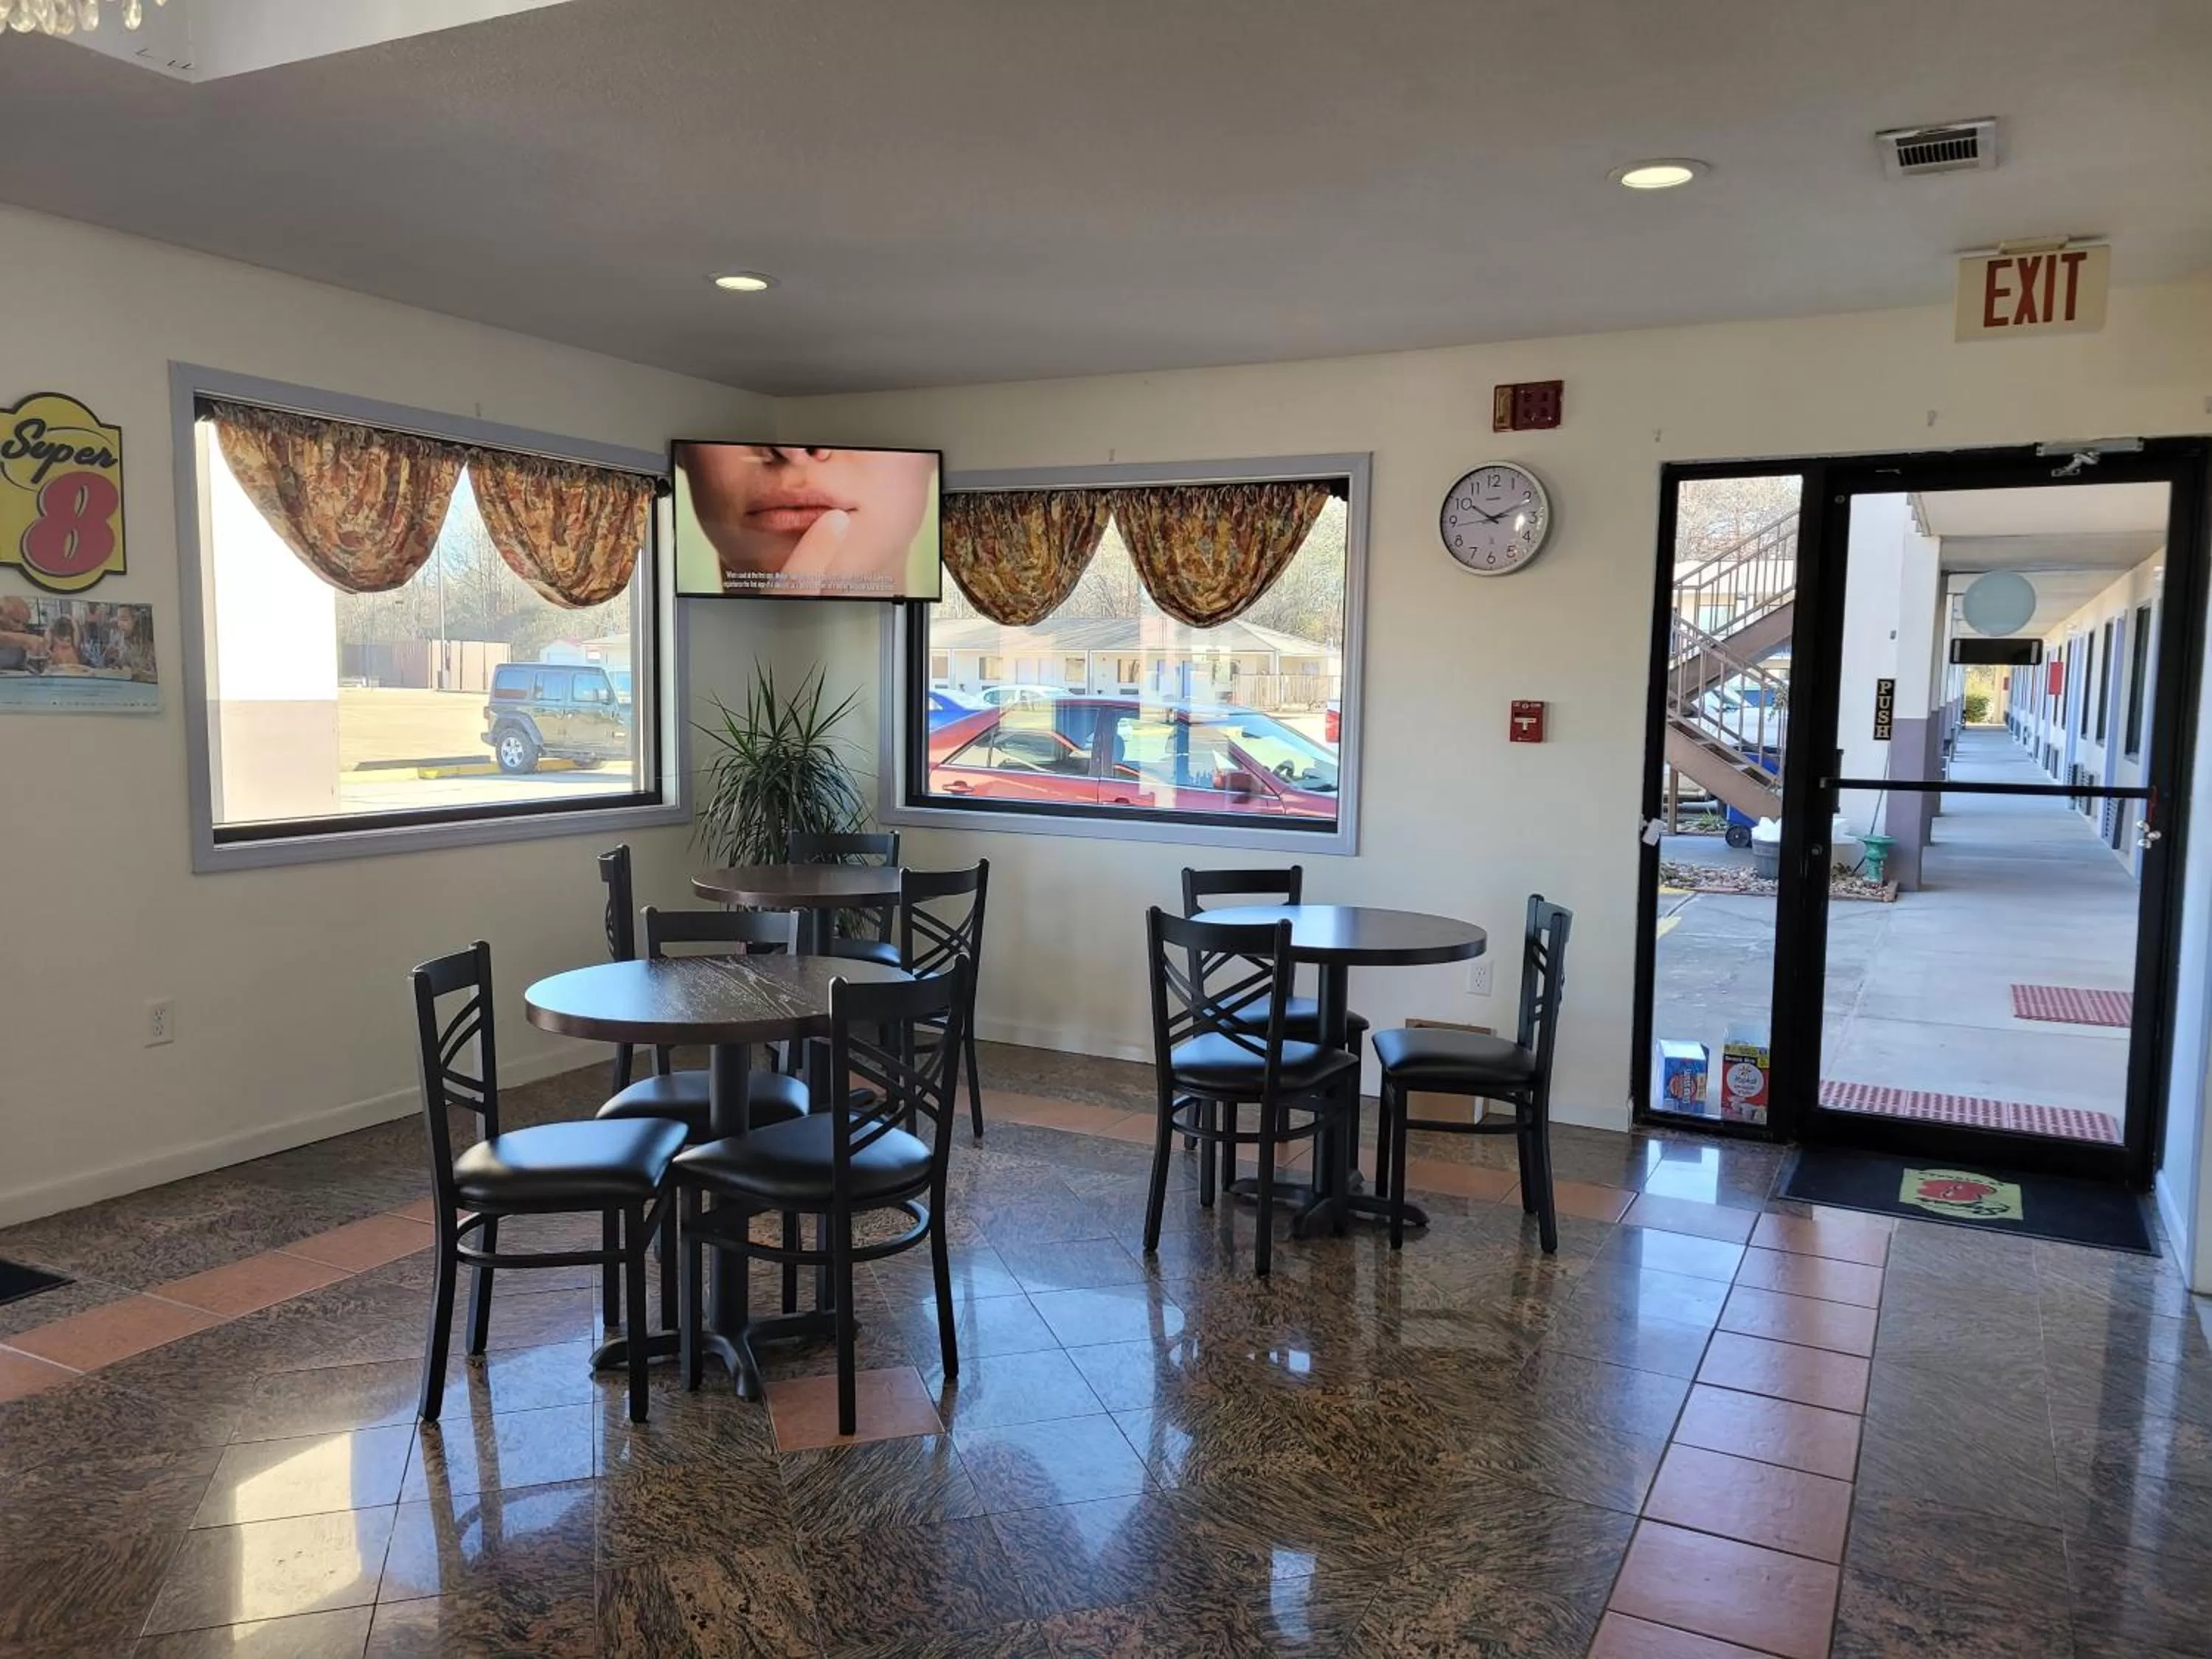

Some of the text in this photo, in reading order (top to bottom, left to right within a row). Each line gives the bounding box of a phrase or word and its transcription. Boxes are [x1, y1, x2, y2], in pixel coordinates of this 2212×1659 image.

[1983, 251, 2087, 328] EXIT
[1, 417, 119, 484] Super
[1470, 481, 1480, 495] 11
[1487, 474, 1500, 488] 12
[1511, 477, 1515, 490] 1
[1455, 498, 1472, 510] 10
[1523, 490, 1532, 504] 2
[21, 471, 119, 577] 8
[1449, 515, 1458, 528] 9
[1528, 510, 1537, 524] 3
[1454, 535, 1463, 547] 8
[1522, 530, 1531, 543] 4
[1469, 546, 1478, 560] 7
[1486, 551, 1496, 564] 6
[1506, 545, 1516, 558] 5
[1875, 681, 1893, 738] PUSH
